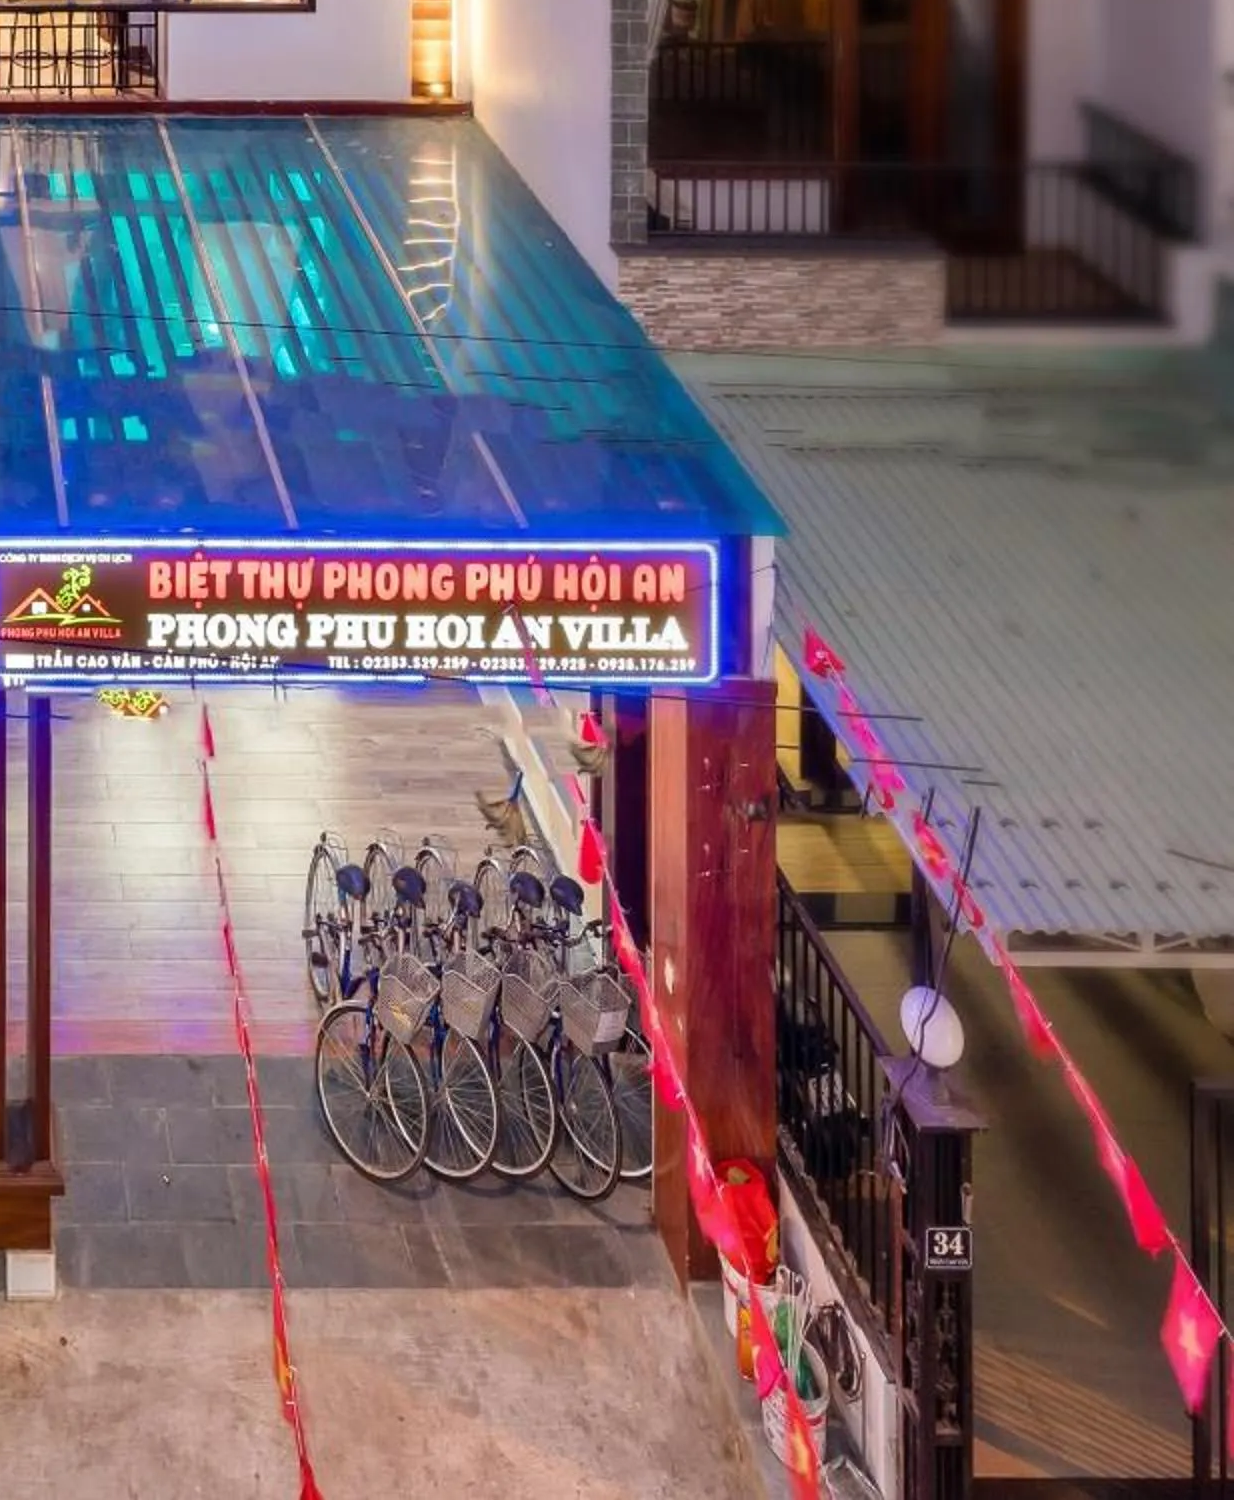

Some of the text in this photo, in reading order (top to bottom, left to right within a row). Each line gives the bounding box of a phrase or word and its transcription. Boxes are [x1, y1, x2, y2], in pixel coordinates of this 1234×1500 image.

[148, 551, 685, 613] BIỆT THỰ PHONG PHÚ HỘI AN
[0, 626, 122, 639] PHONG PHU HOI AN VILLA
[147, 612, 689, 650] PHONG PHU HOI AN VILLA
[76, 653, 109, 669] CAO
[111, 651, 142, 669] VÂN
[327, 655, 351, 669] TEL
[933, 1231, 965, 1256] 34
